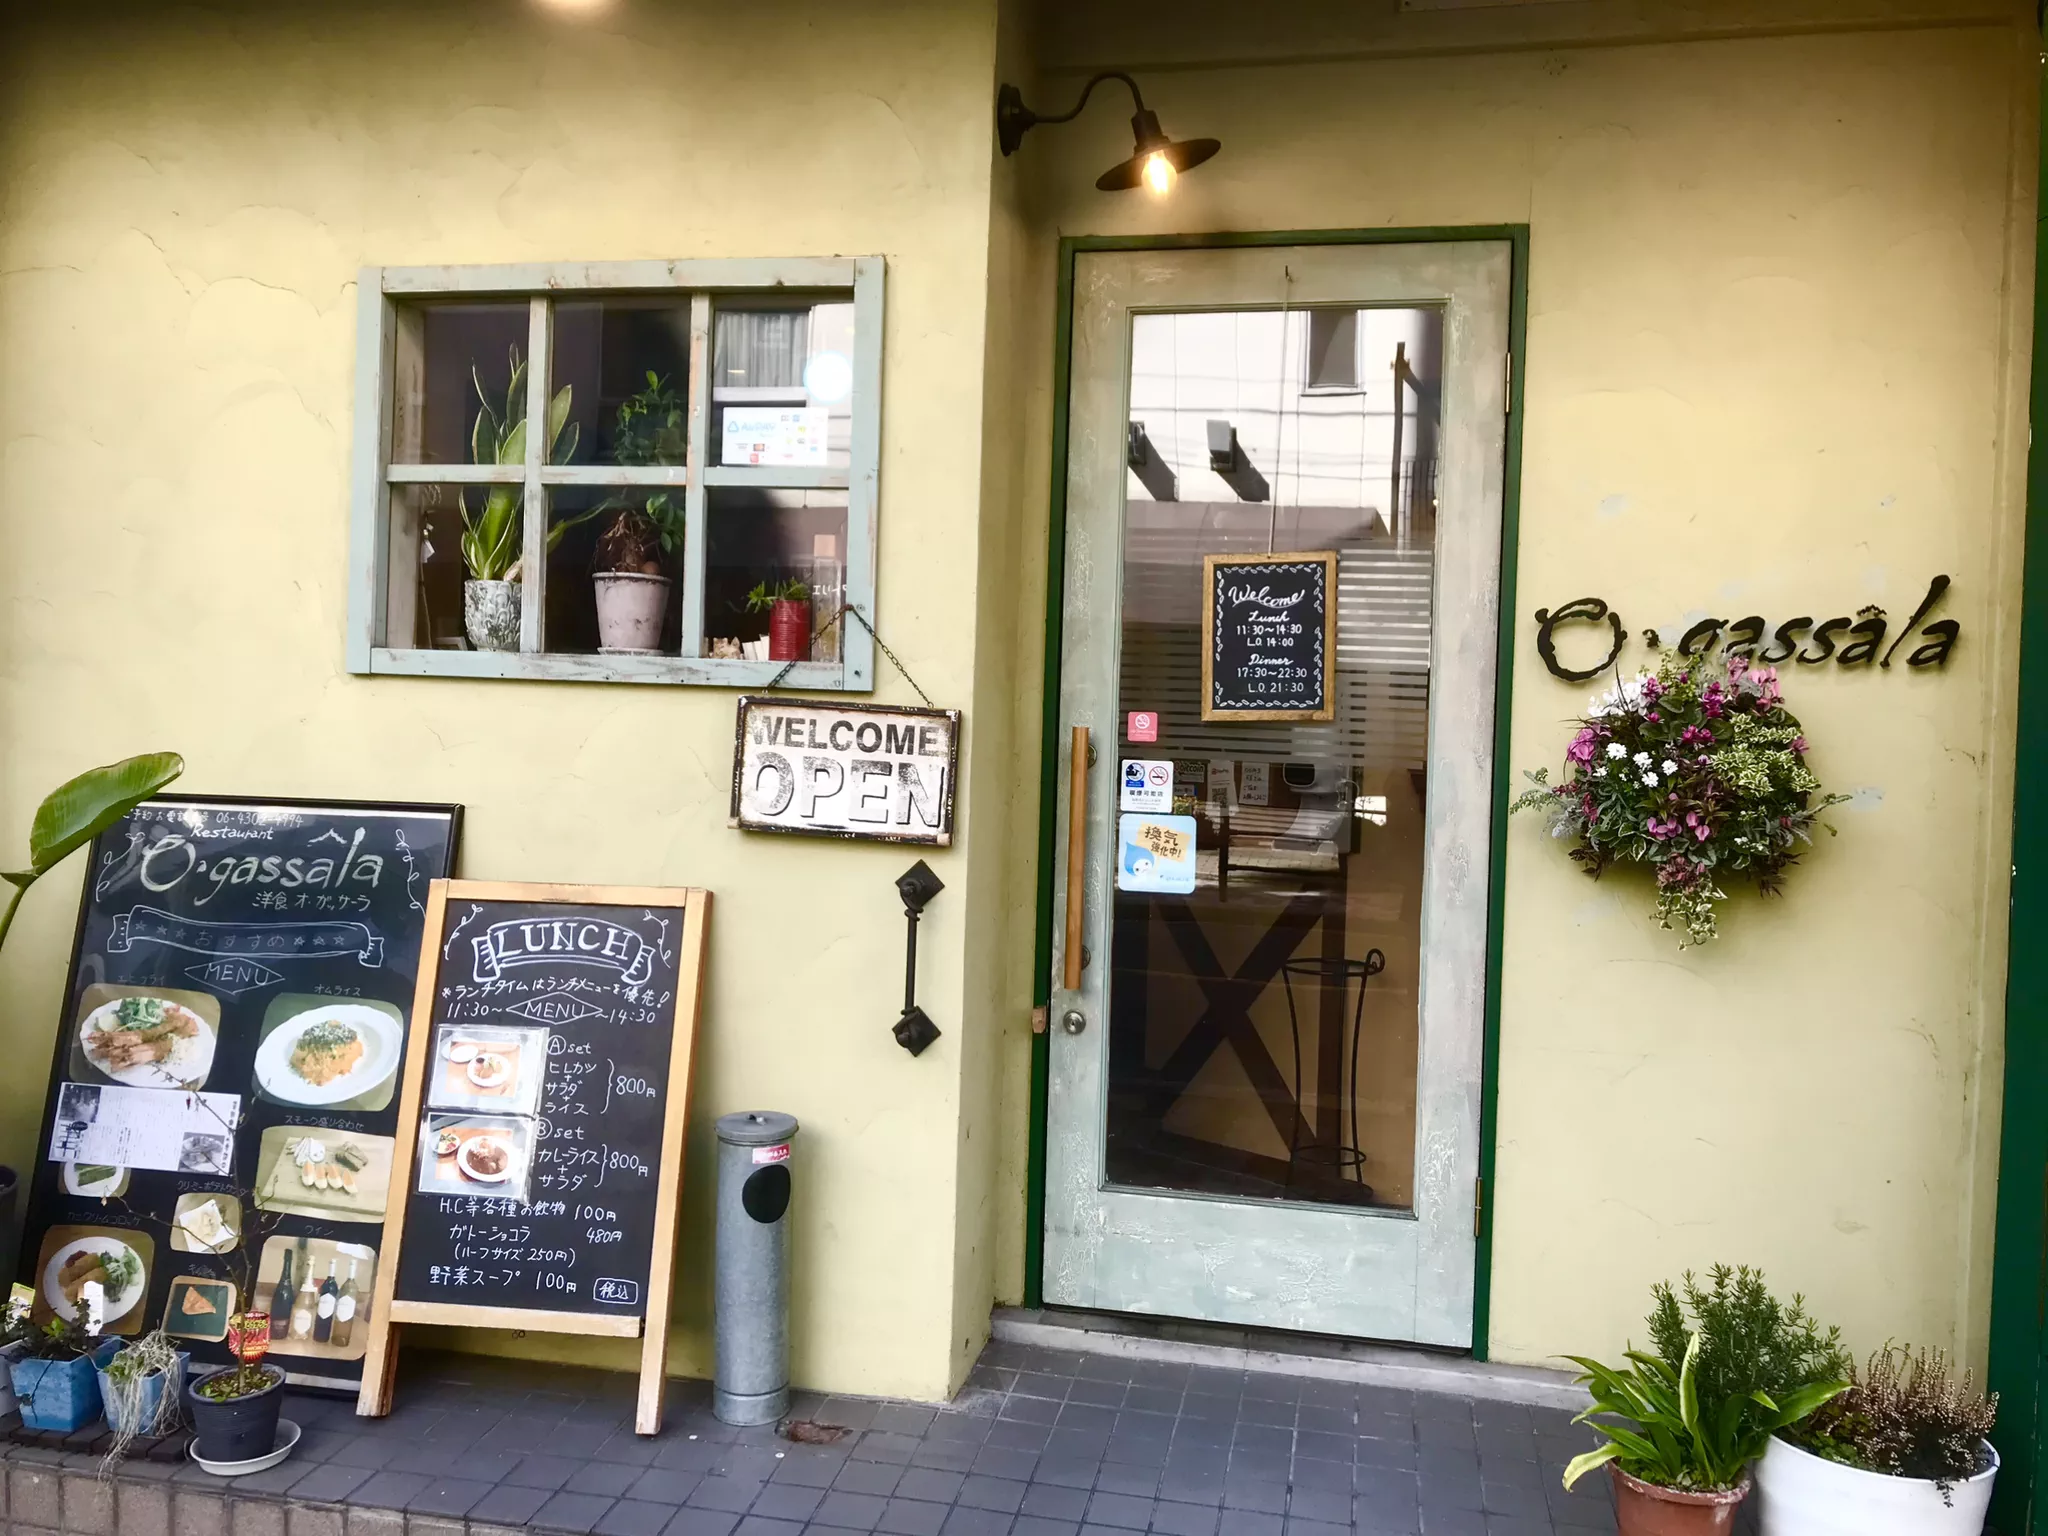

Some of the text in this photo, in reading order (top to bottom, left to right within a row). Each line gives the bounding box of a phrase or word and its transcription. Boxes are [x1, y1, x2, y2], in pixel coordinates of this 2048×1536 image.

[1228, 585, 1306, 608] Welcome
[1248, 610, 1290, 622] Lunch
[1266, 637, 1294, 647] 14:00
[1248, 653, 1293, 665] Dinner
[1270, 682, 1304, 692] 21:30
[751, 715, 946, 757] WELCOME
[754, 752, 945, 828] OPEN
[191, 824, 273, 840] Restaurant
[1144, 826, 1178, 846] 換気
[252, 891, 288, 910] 洋食
[195, 930, 285, 950] おすすめ
[494, 921, 633, 960] LUNCH
[204, 963, 270, 986] MENU
[524, 1001, 586, 1018] MENU
[567, 1043, 592, 1054] set
[549, 1061, 597, 1075] ヒレカツ
[545, 1075, 656, 1098] サラダ 800円
[545, 1102, 589, 1115] ライス
[554, 1124, 584, 1140] set
[538, 1148, 648, 1177] カレーライス 800円
[539, 1174, 588, 1191] サラダ
[574, 1204, 617, 1222] 100円
[449, 1224, 623, 1244] ガトーショコラ 480円
[430, 1265, 577, 1293] 野菜スープ 100円
[599, 1282, 629, 1301] 税込
